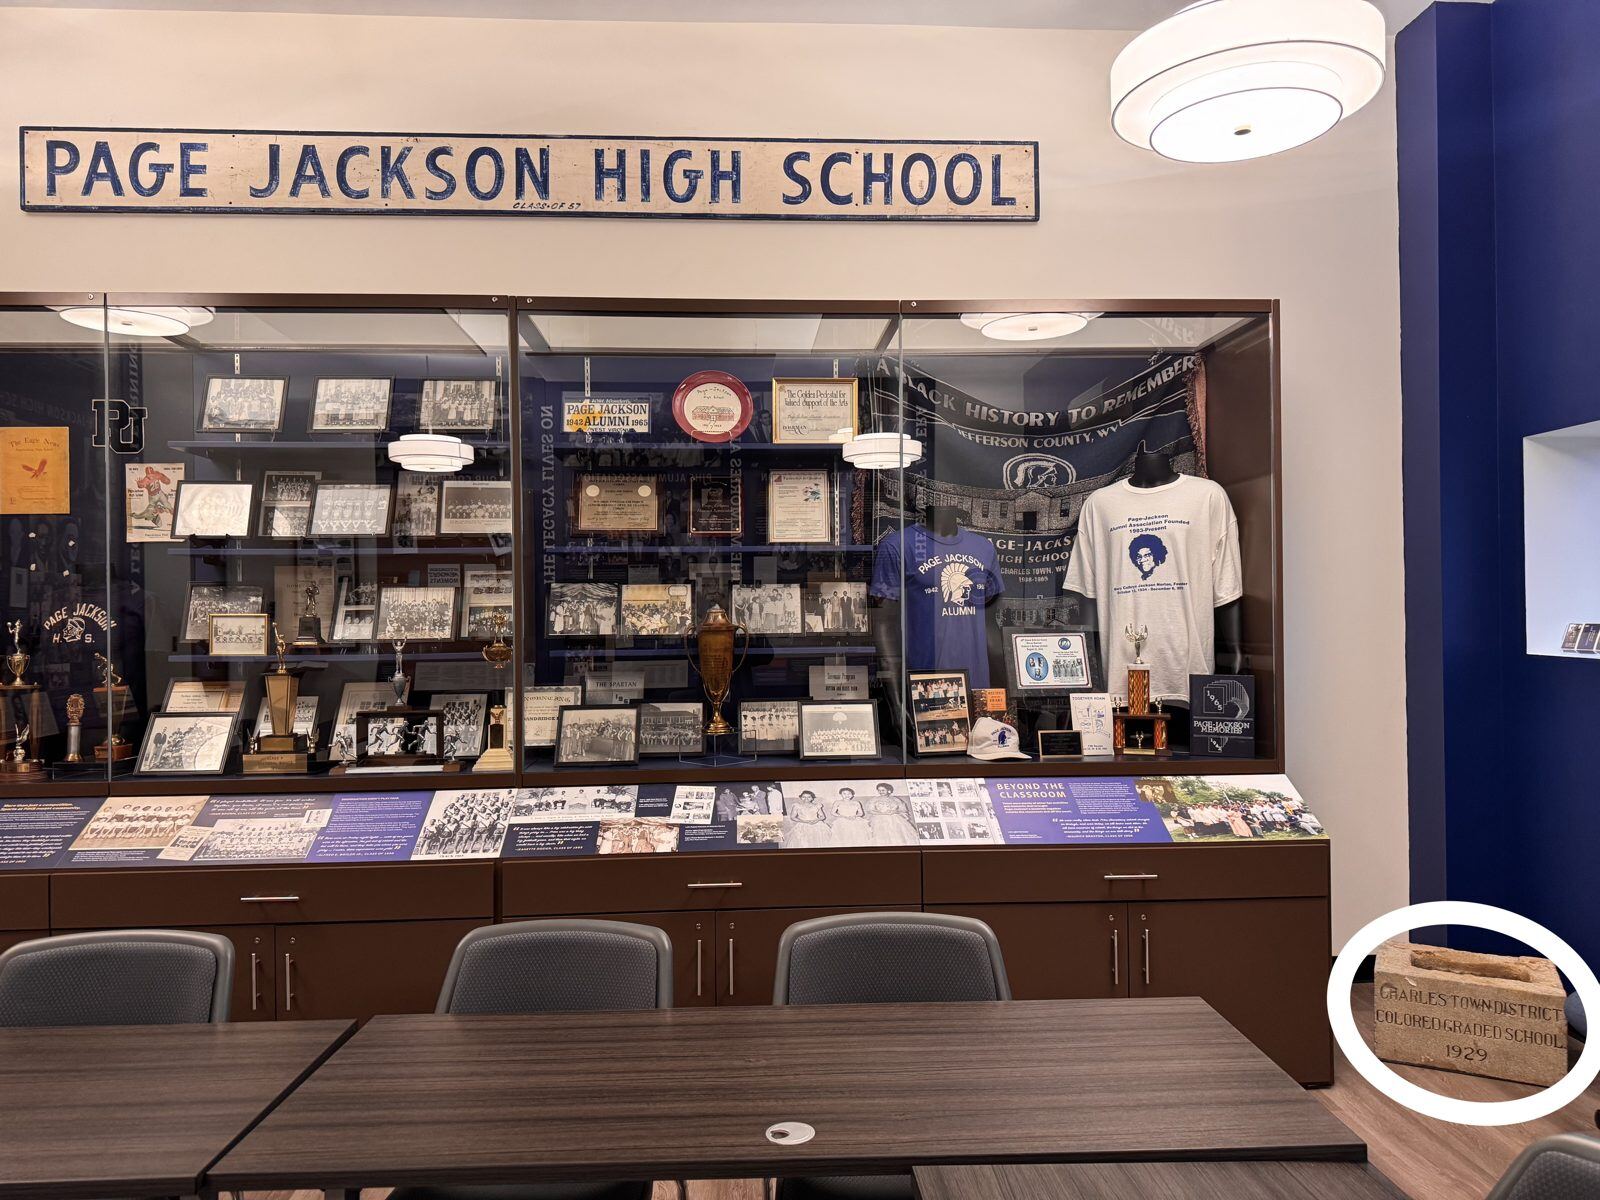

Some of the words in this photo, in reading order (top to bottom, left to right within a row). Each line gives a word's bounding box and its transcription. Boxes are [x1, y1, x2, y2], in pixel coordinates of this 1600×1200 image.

[46, 140, 208, 197] PAGE
[249, 144, 549, 201] JACKSON
[595, 148, 742, 203] HIGH
[783, 152, 1017, 207] SCHOOL
[568, 202, 582, 210] 57
[787, 389, 796, 399] The
[797, 389, 815, 399] Golden
[816, 389, 839, 399] Pedestal
[839, 389, 847, 399] for
[876, 357, 891, 376] A
[964, 401, 1060, 427] HISTORY
[1067, 405, 1097, 424] TO
[1102, 355, 1197, 415] REMEMBER
[802, 398, 823, 409] Support
[823, 398, 830, 407] of
[839, 398, 849, 407] Arts
[567, 404, 595, 415] PAGE
[598, 404, 647, 415] JACKSON
[584, 416, 630, 427] ALUMNI
[956, 428, 1028, 448] JEFFERSON
[1033, 431, 1094, 448] COUNTY,
[1096, 424, 1119, 439] WV
[1127, 514, 1169, 522] Page-Jackson
[1109, 523, 1128, 532] Alumni
[1129, 521, 1162, 529] Association
[1028, 551, 1072, 563] SCHOO
[917, 555, 943, 576] PAGE
[944, 553, 985, 573] JACKSON
[924, 585, 939, 595] 1942
[43, 607, 70, 631] PAGE
[72, 603, 119, 631] JACKSON
[941, 606, 976, 617] ALUMNI
[1206, 690, 1223, 712] 1965
[1193, 721, 1250, 730] PAGE-JACKSON
[1201, 727, 1243, 735] MEMORIES
[1000, 791, 1066, 799] CLASSROOM
[1379, 982, 1447, 1007] CHARLES
[1493, 1002, 1563, 1023] DISTRICT
[1376, 1010, 1441, 1031] COLORED
[1443, 1018, 1502, 1041] GRADED
[1504, 1028, 1564, 1050] SCHOOL
[1445, 1044, 1488, 1062] 1929
